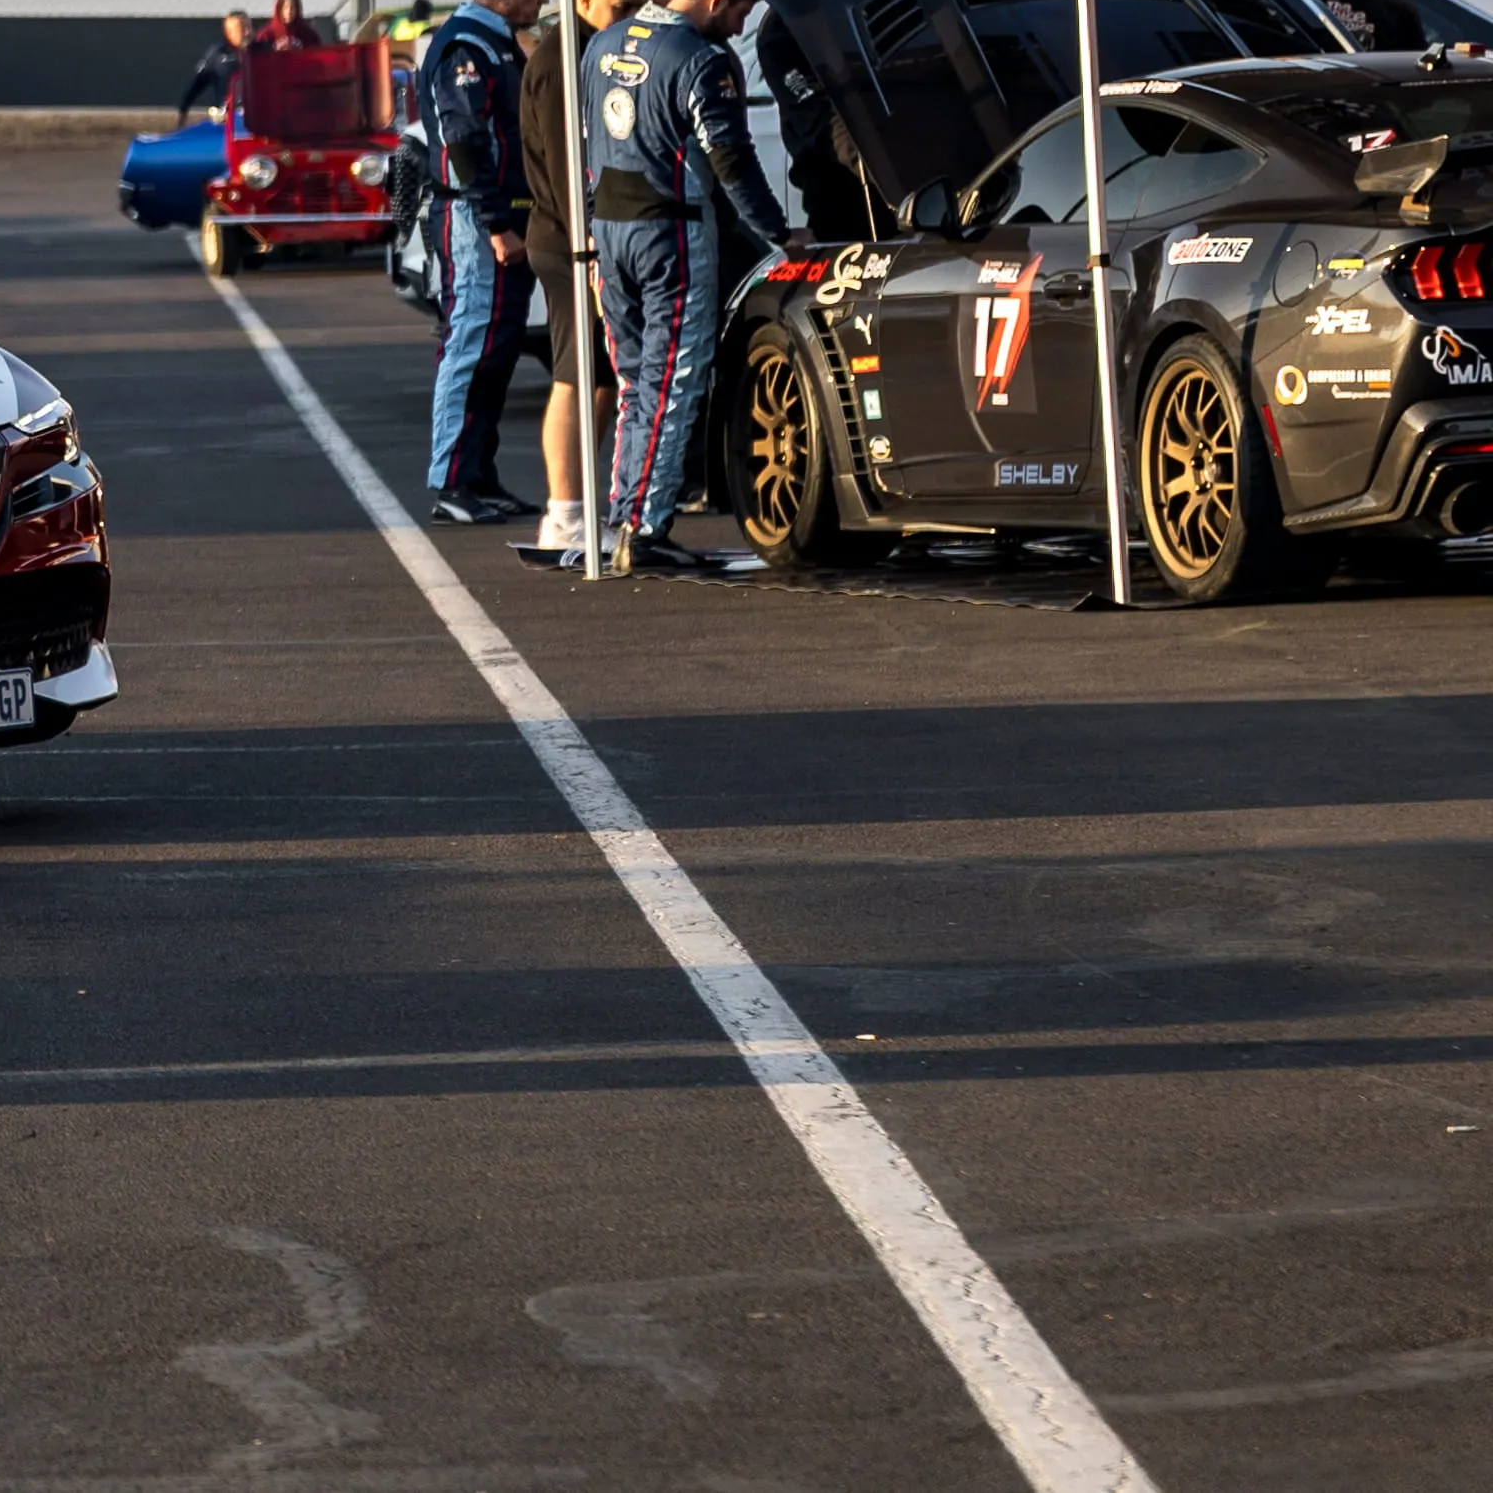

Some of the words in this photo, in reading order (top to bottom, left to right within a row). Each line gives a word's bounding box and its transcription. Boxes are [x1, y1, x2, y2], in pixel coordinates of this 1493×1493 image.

[1348, 129, 1394, 152] 17
[767, 258, 830, 282] Castol
[1312, 305, 1372, 335] XPEL
[974, 297, 1021, 377] 17
[1000, 464, 1079, 485] SHELBY
